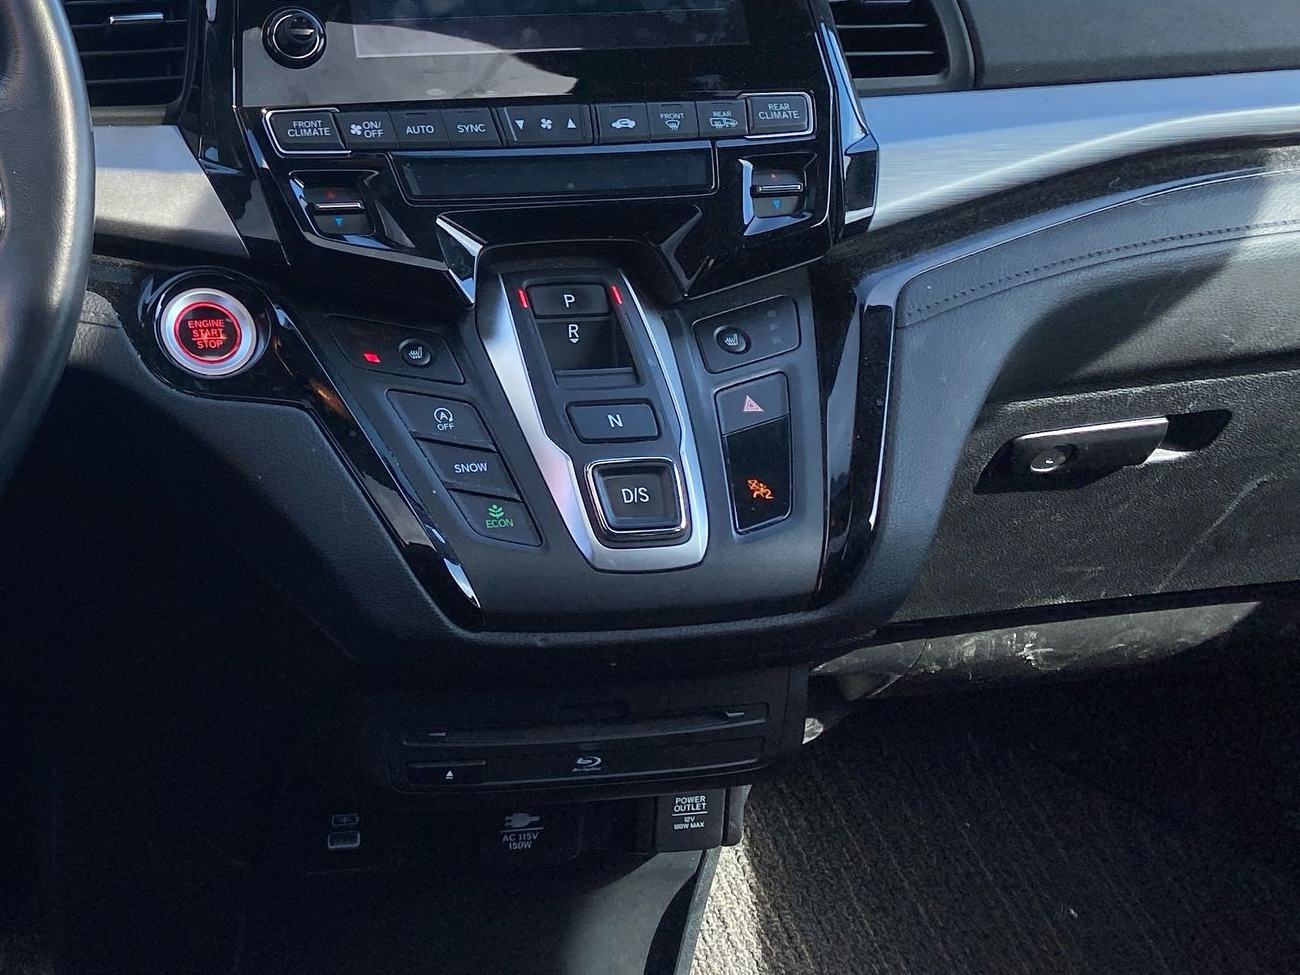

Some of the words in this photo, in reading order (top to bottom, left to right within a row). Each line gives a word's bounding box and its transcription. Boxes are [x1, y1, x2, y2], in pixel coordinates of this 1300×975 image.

[768, 103, 790, 111] REAR
[758, 110, 800, 120] CLIMATE
[292, 120, 323, 128] FRONT
[362, 120, 381, 130] ON/
[457, 124, 486, 133] SYNC
[287, 127, 331, 138] CLIMATE
[364, 129, 384, 138] OFF
[406, 125, 435, 135] AUTO
[563, 294, 576, 308] P
[187, 319, 225, 329] ENGINE
[192, 328, 224, 337] START
[568, 324, 579, 338] R
[197, 340, 224, 349] STOP
[607, 414, 623, 428] N
[437, 423, 454, 431] OFF
[454, 463, 488, 473] SNOW
[621, 487, 650, 504] D/S
[485, 518, 514, 528] ECON
[675, 795, 706, 805] POWER
[673, 803, 707, 812] OUTLET
[502, 833, 516, 842] AC
[518, 832, 539, 840] 115V
[508, 841, 532, 850] 150W
